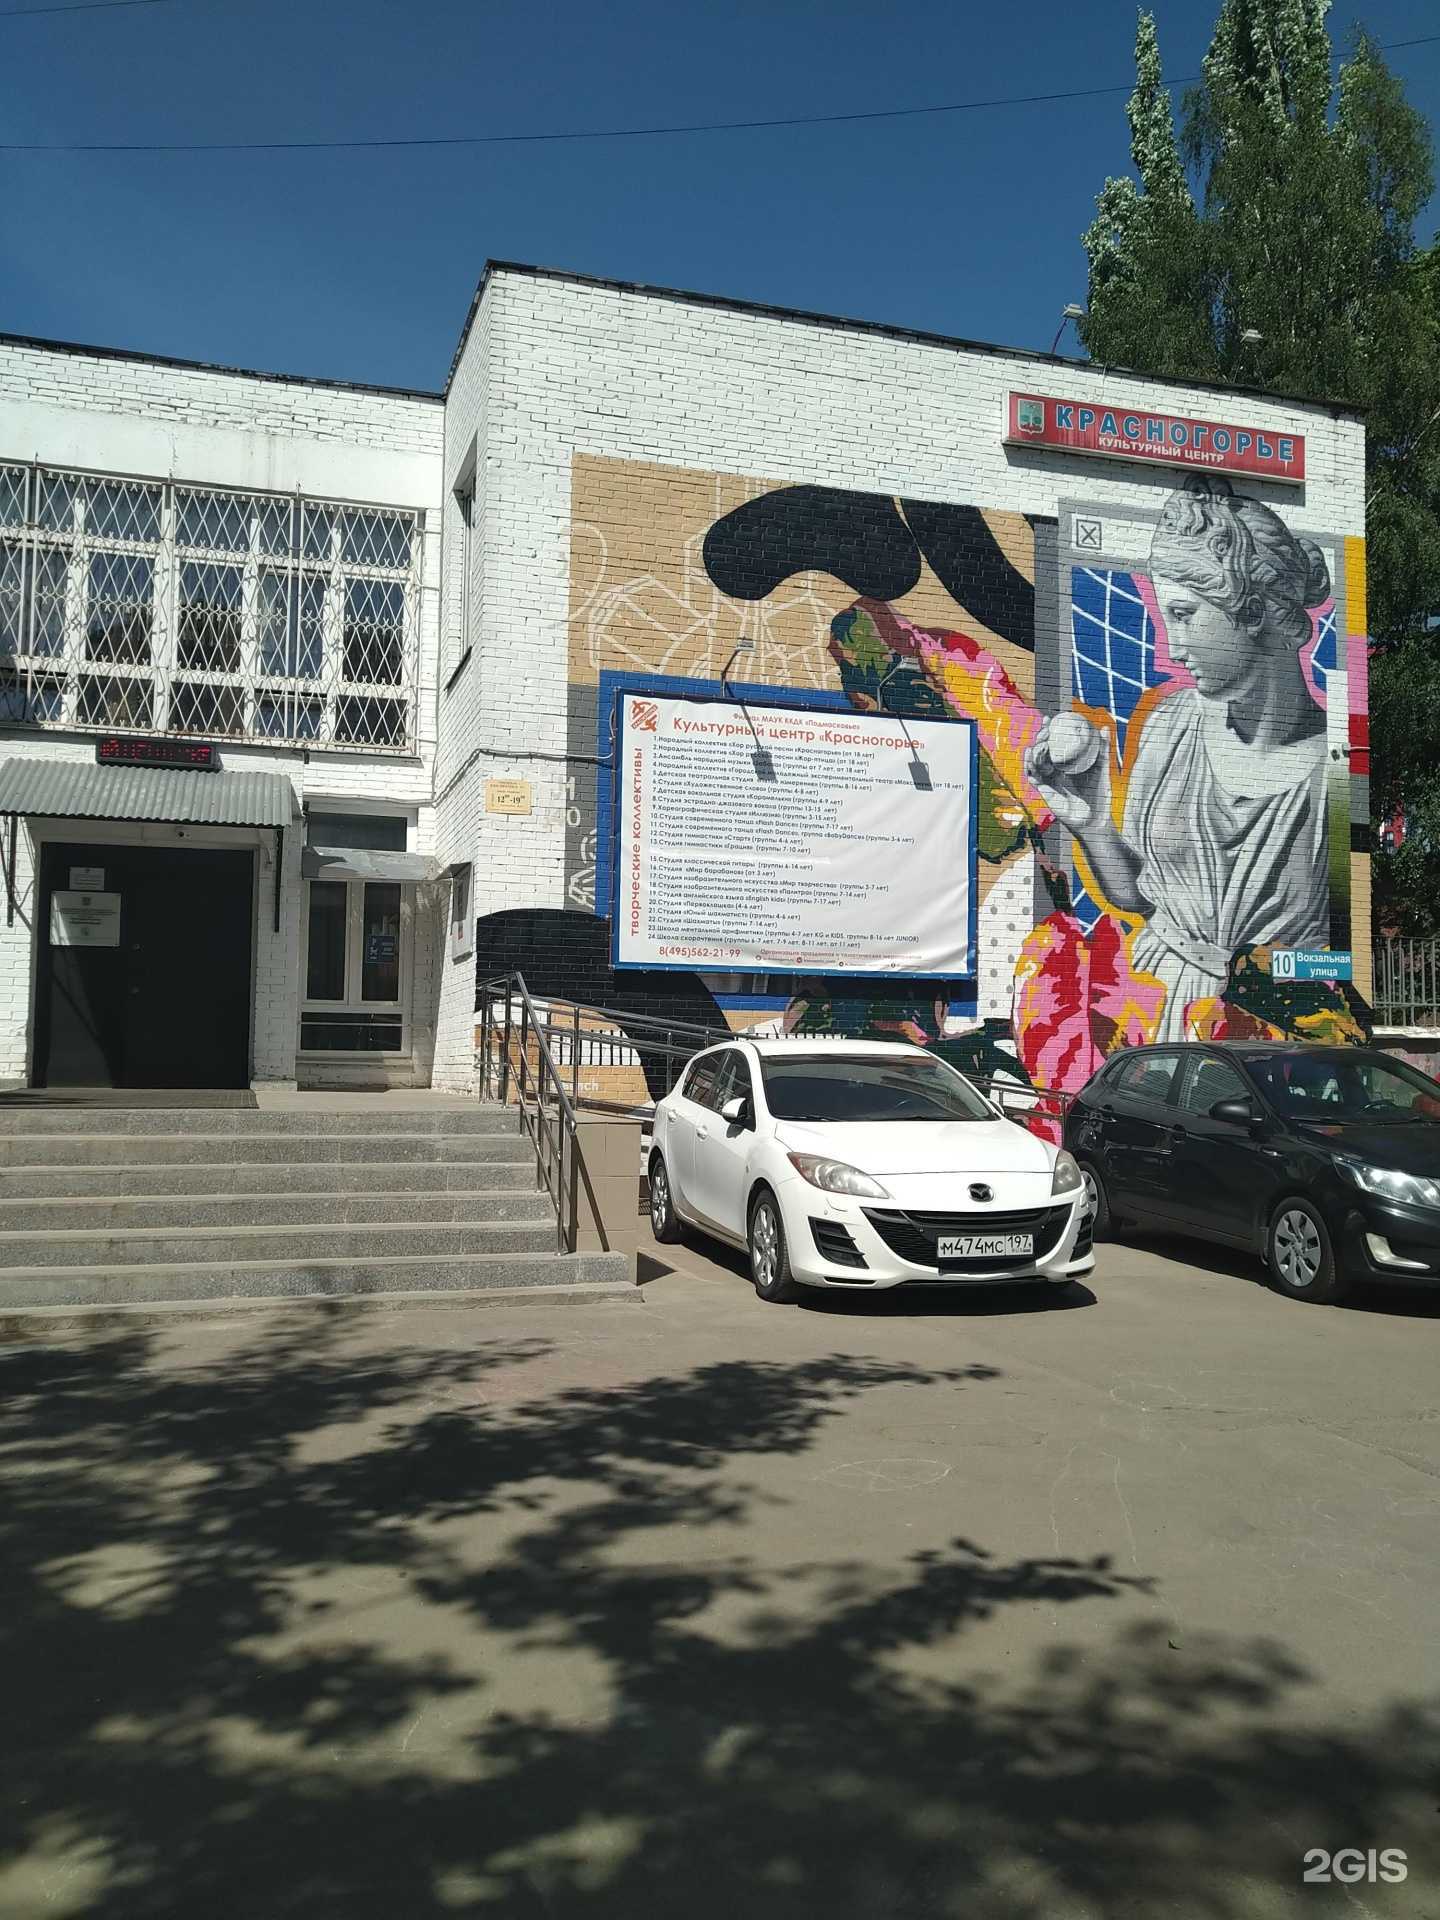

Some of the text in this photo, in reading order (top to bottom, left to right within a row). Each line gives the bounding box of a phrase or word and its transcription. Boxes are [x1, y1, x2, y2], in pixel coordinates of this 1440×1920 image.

[1055, 404, 1295, 461] КРАСНОГОРЬЕ
[1098, 436, 1225, 463] КУЛЬТУРНЫЙ ЦЕНТР
[761, 715, 783, 724] МАУК
[673, 716, 764, 739] Культурный
[769, 727, 815, 743] центр
[819, 728, 924, 752] «Красногорье»
[632, 747, 642, 936] творческие коллективы
[658, 945, 740, 959] 8(495)562-21-99
[1273, 952, 1351, 975] 10 Вокзальная
[1309, 967, 1338, 978] улица
[942, 1235, 1029, 1255] М474МС 197
